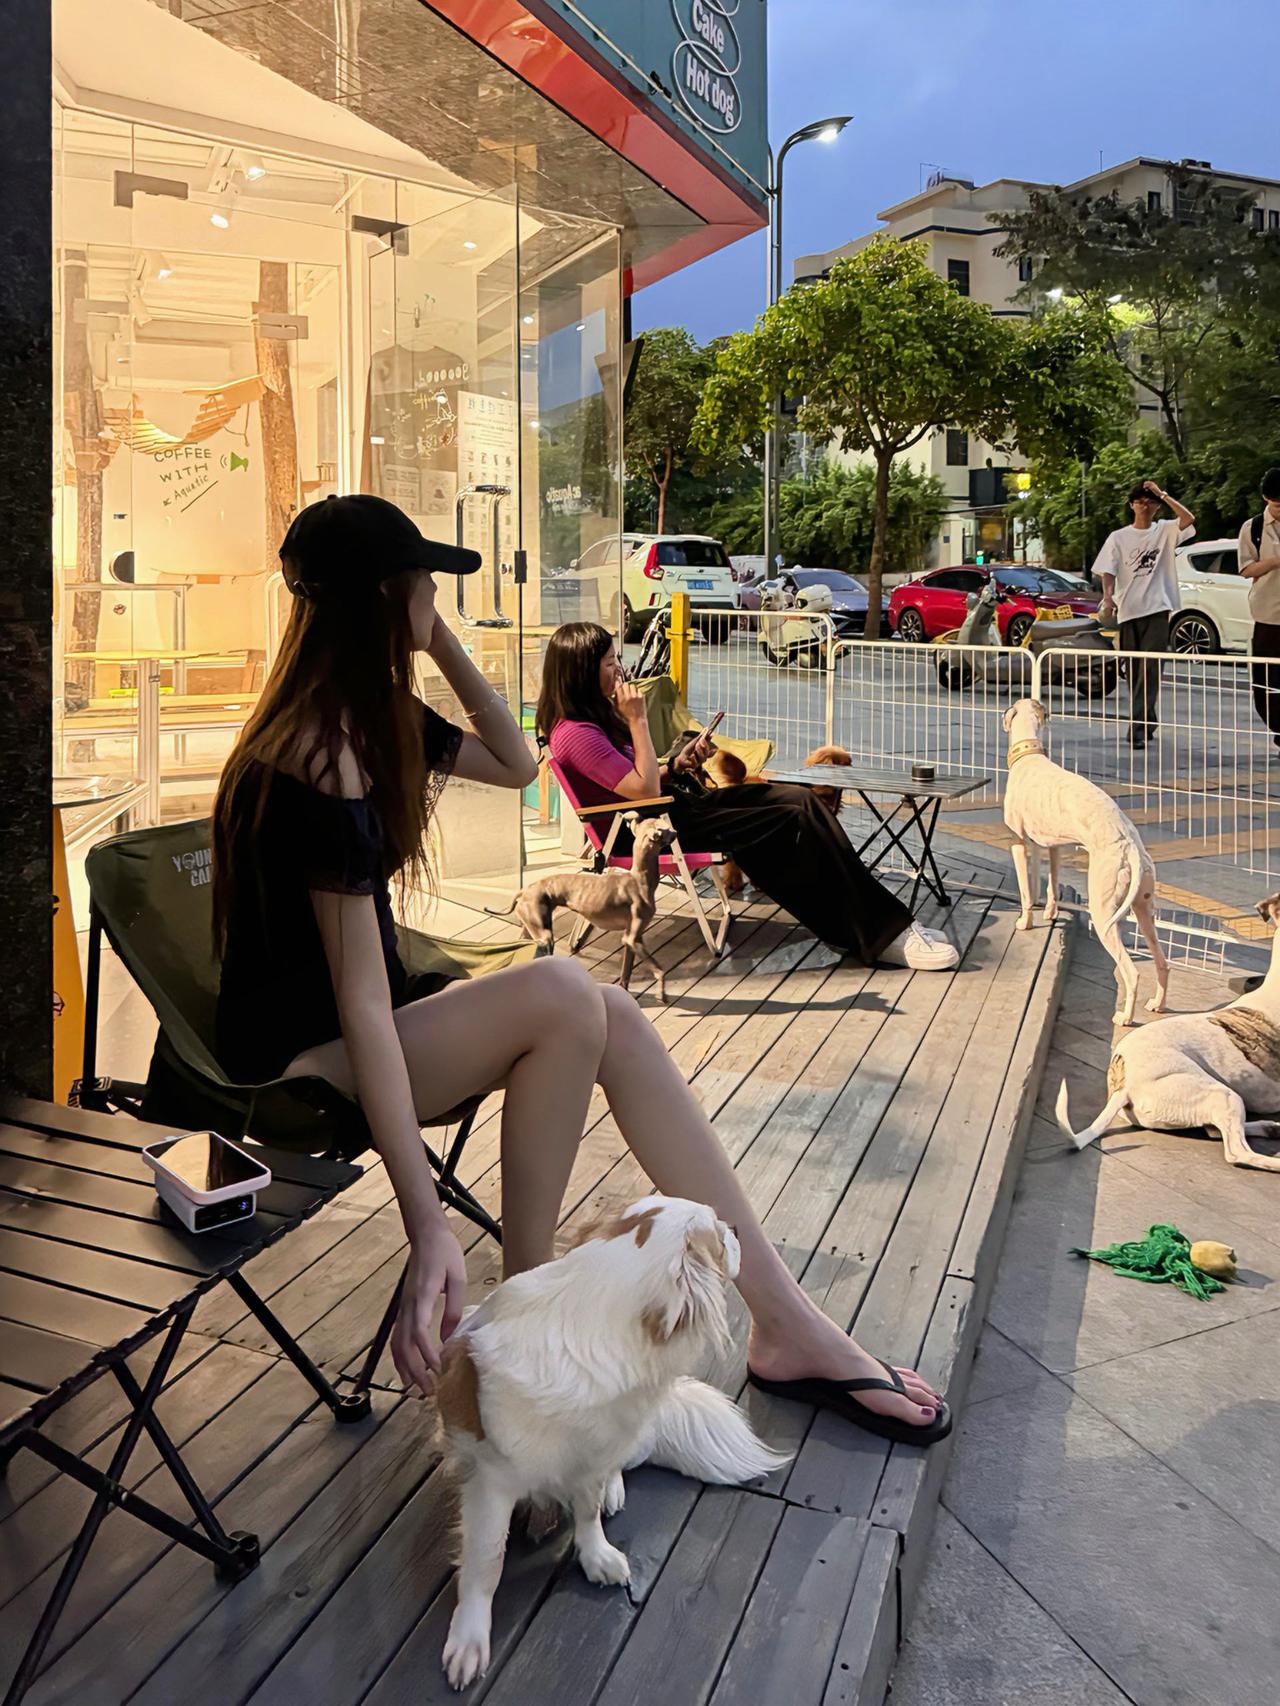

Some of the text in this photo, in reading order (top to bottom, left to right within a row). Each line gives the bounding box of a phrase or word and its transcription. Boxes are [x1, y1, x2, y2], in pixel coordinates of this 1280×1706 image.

[692, 0, 725, 53] Cake
[686, 52, 735, 127] Hot dog
[154, 447, 212, 462] COFFEE
[159, 463, 208, 482] WITH
[174, 474, 209, 500] Aquatic
